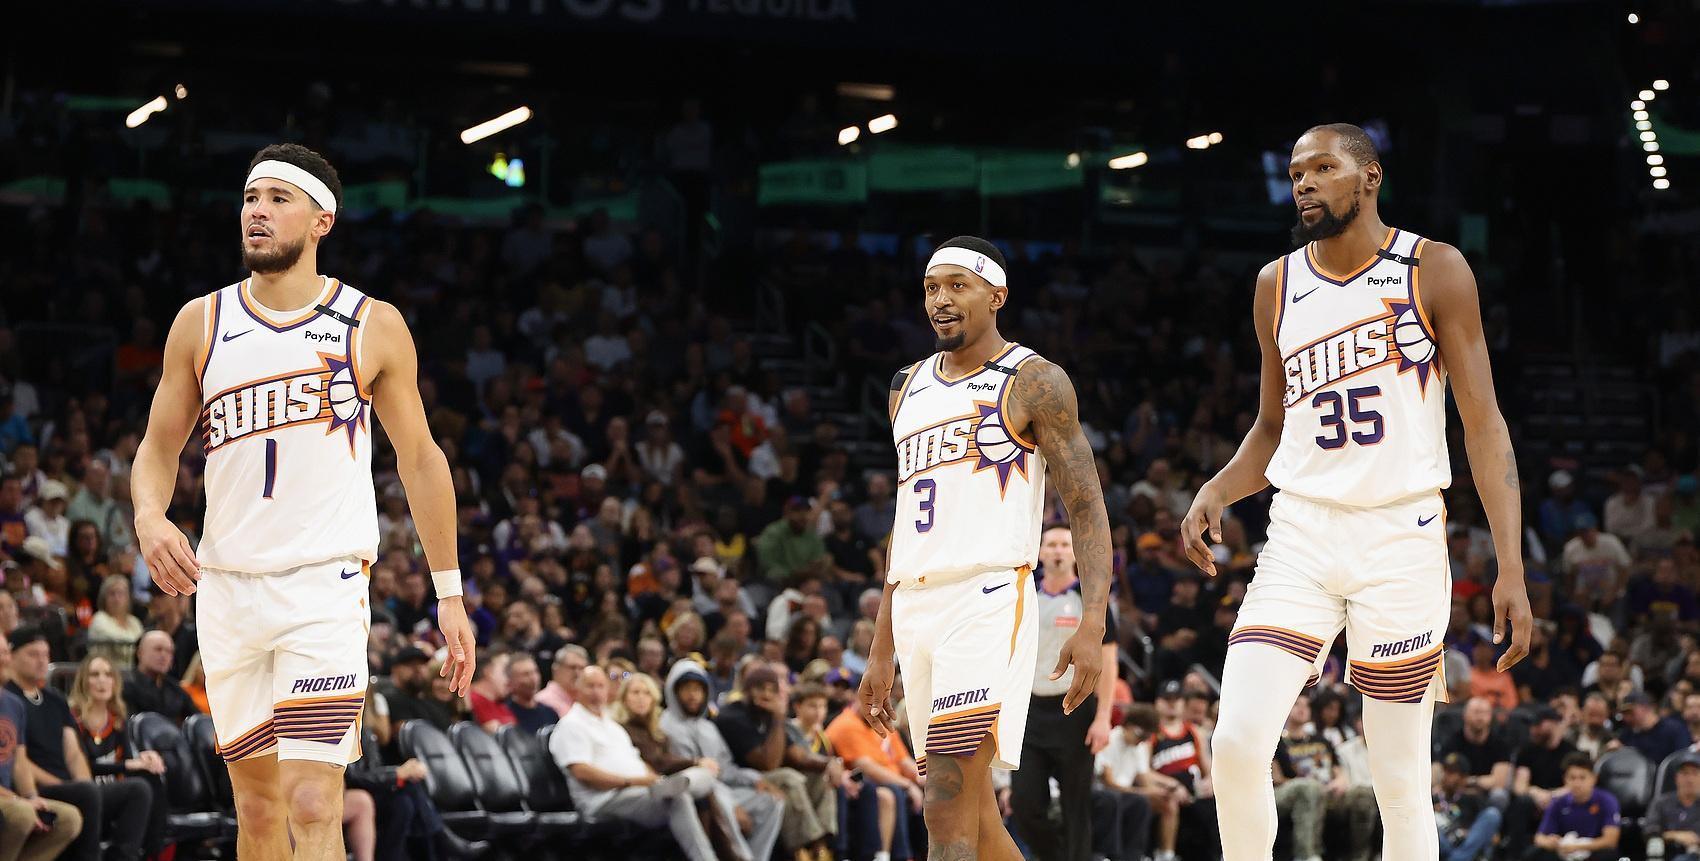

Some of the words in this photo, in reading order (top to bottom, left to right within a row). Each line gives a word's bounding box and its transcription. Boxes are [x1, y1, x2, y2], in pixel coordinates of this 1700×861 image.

[1367, 276, 1402, 289] PayPal
[304, 330, 341, 344] PayPal
[966, 382, 997, 393] PayPal
[208, 374, 324, 449] SUNS
[1312, 385, 1385, 451] 35
[897, 420, 972, 483] UNS
[262, 438, 279, 501] 1
[913, 478, 937, 534] 3
[1370, 629, 1433, 658] PHOENIX
[291, 672, 357, 694] PHOENIX
[931, 687, 990, 714] PHOENIX
